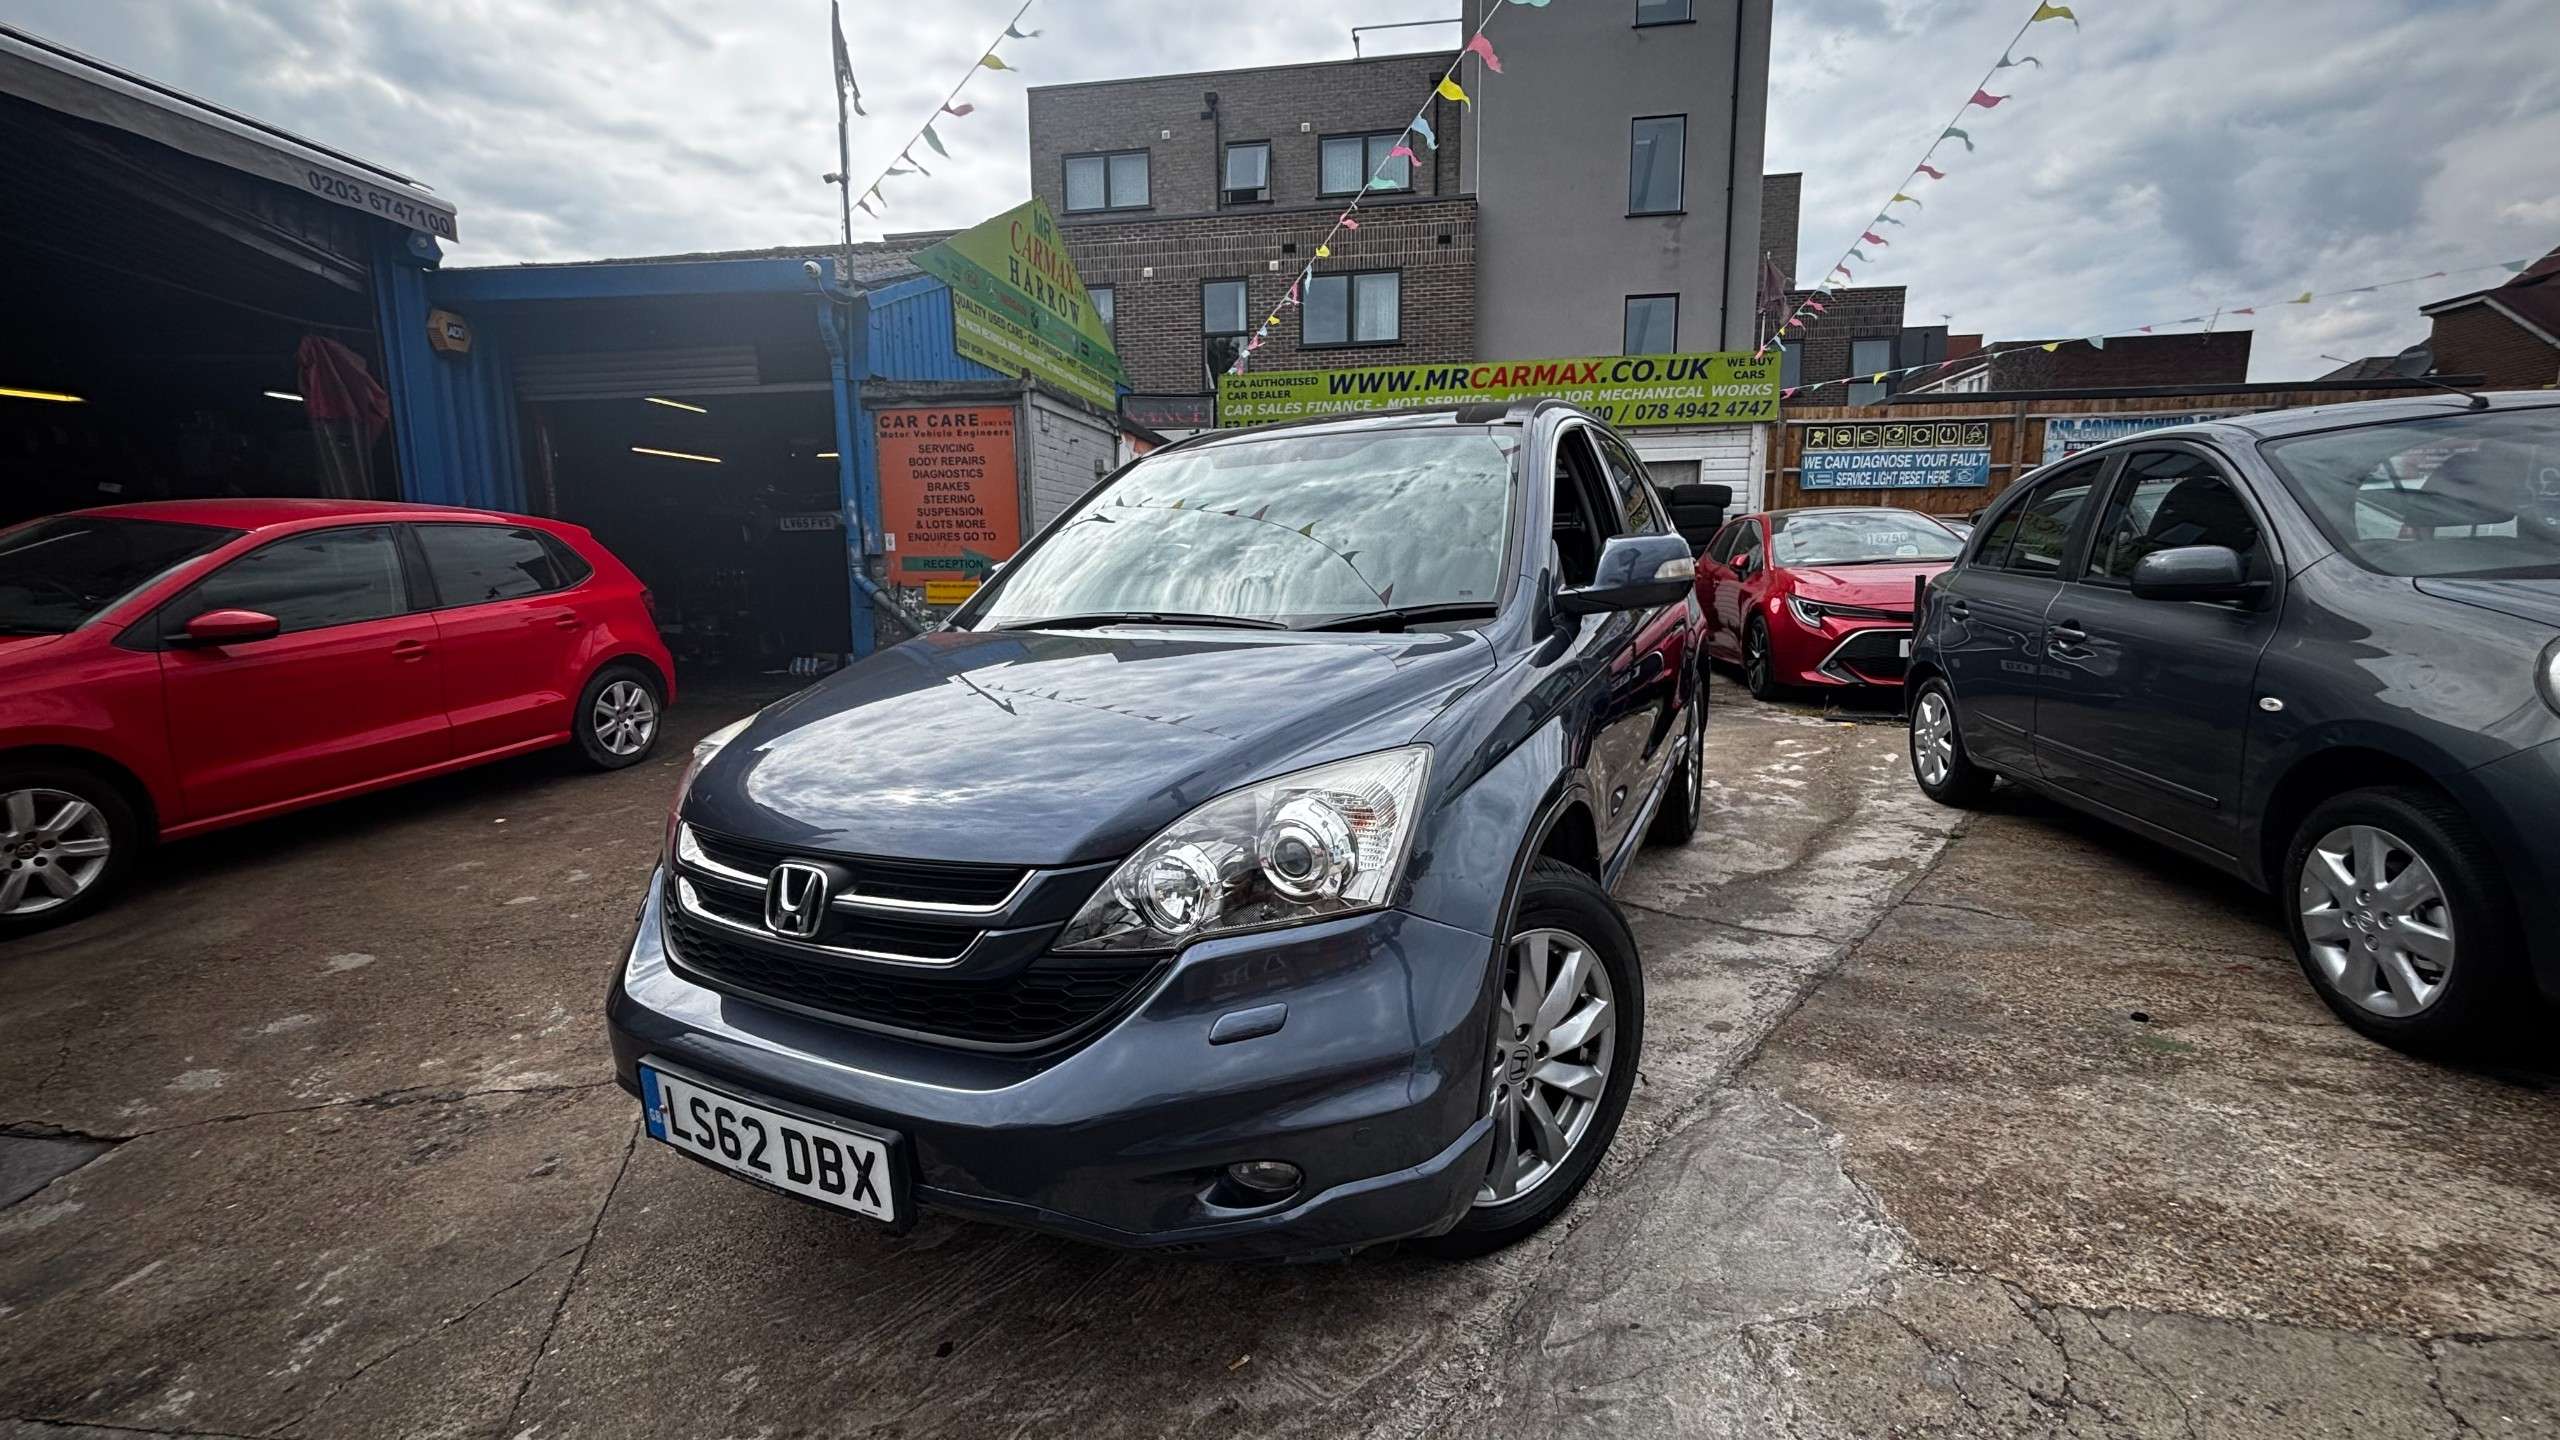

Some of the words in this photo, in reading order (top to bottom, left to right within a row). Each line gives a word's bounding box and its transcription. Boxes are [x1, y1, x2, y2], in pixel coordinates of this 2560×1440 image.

[308, 170, 363, 204] 0203
[368, 191, 451, 235] 6747100
[1033, 208, 1052, 245] MR
[1010, 220, 1076, 298] CARMAX
[1008, 254, 1080, 326] HARROW
[954, 293, 987, 320] QUALITY
[988, 312, 1006, 330] USED
[1007, 322, 1025, 341] CARS
[1727, 358, 1745, 367] WE
[1749, 357, 1775, 366] BUY
[1329, 357, 1712, 395] WWW.MRCARMAX.CO.UK
[1733, 370, 1766, 380] CARS
[1226, 379, 1247, 389] FCA
[1249, 376, 1319, 387] AUTHORISED
[1223, 404, 1252, 416] CAR
[1257, 402, 1303, 415] SALES
[1305, 400, 1372, 414] FINANCE
[1386, 396, 1422, 410] MOT
[1425, 395, 1492, 406] SERVICE
[1599, 386, 1705, 401] MECHANICAL
[1710, 383, 1774, 397] WORKS
[1226, 391, 1248, 401] CAR
[1250, 389, 1292, 400] DEALER
[1635, 403, 1669, 420] 078
[1674, 402, 1720, 419] 4942
[1725, 400, 1773, 417] 4747
[879, 415, 918, 429] CAR
[927, 413, 979, 428] CARE
[879, 431, 909, 439] Motor
[914, 430, 953, 438] Vehicle
[956, 429, 1010, 438] Engineers
[918, 443, 975, 454] SERVICING
[908, 456, 938, 467] BODY
[940, 455, 986, 466] REPAIRS
[1803, 456, 1822, 470] WE
[1824, 455, 1850, 469] CAN
[1851, 454, 1912, 469] DIAGNOSE
[1915, 453, 1947, 468] YOUR
[1949, 453, 1988, 467] FAULT
[912, 468, 984, 480] DIAGNOSTICS
[1835, 472, 1872, 486] SERVICE
[1872, 471, 1898, 486] LIGHT
[1898, 470, 1925, 485] RESET
[1927, 470, 1951, 484] HERE
[927, 481, 971, 492] BRAKES
[923, 494, 976, 505] STEERING
[916, 507, 984, 518] SUSPENSION
[926, 520, 953, 529] LOTS
[955, 519, 986, 529] MORE
[907, 532, 961, 542] ENQUIRES
[963, 532, 980, 541] GO
[982, 532, 997, 541] TO
[923, 559, 984, 569] RECEPTION
[664, 1085, 773, 1174] LS62
[780, 1126, 882, 1209] DBX
